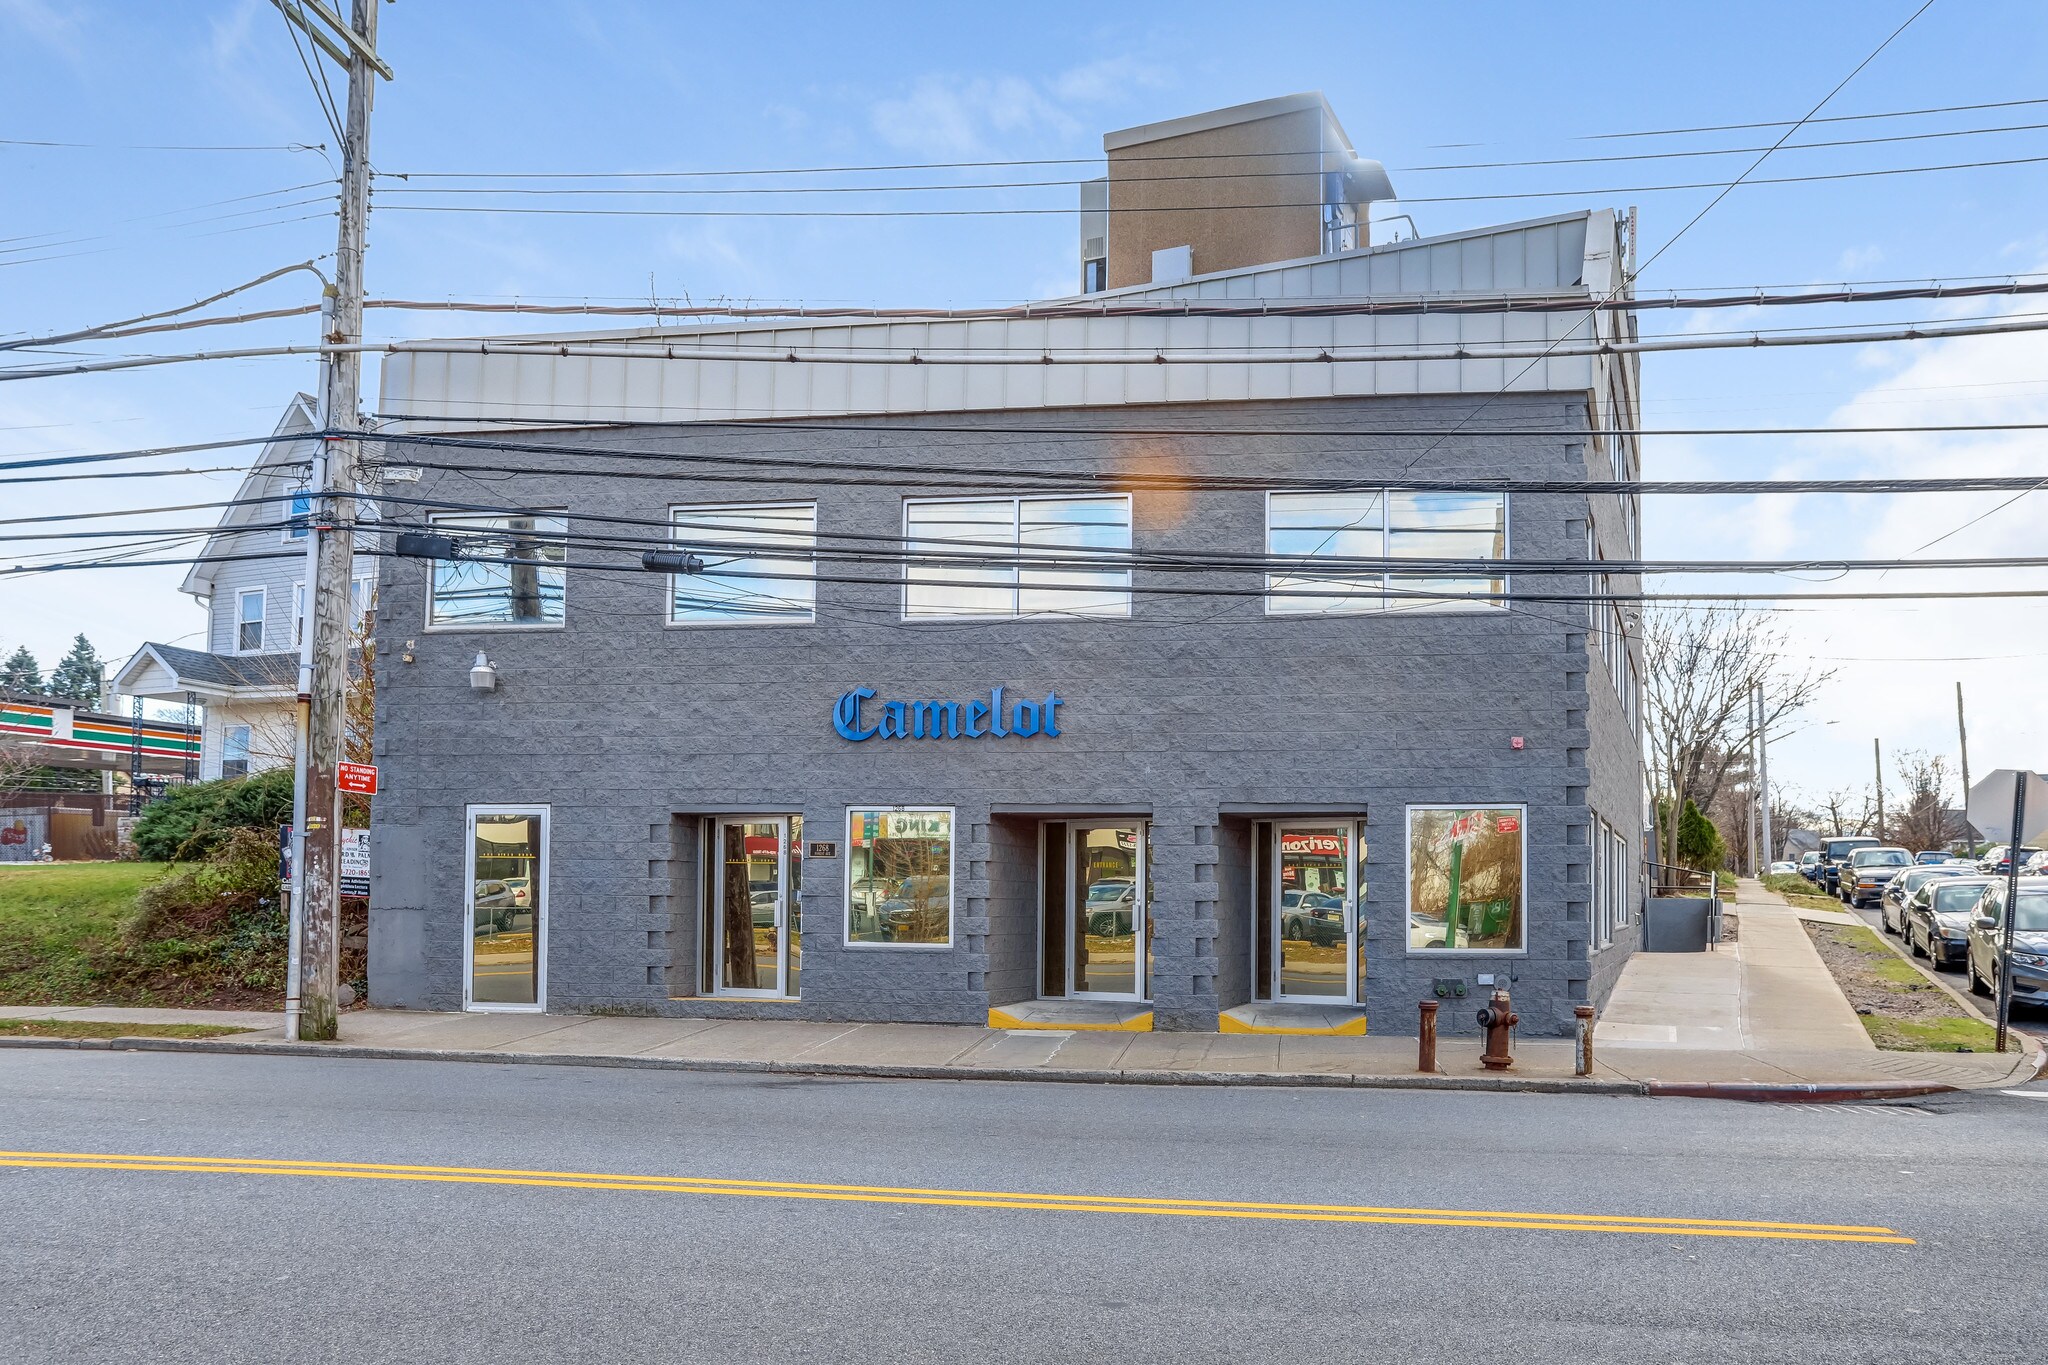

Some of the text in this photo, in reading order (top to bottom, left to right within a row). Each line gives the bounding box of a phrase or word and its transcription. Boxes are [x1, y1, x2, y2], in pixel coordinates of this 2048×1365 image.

[832, 685, 1064, 742] Camelot
[350, 766, 375, 776] STANDING
[344, 773, 371, 782] ANYTIME
[341, 836, 358, 845] ychic
[816, 844, 830, 852] 1268
